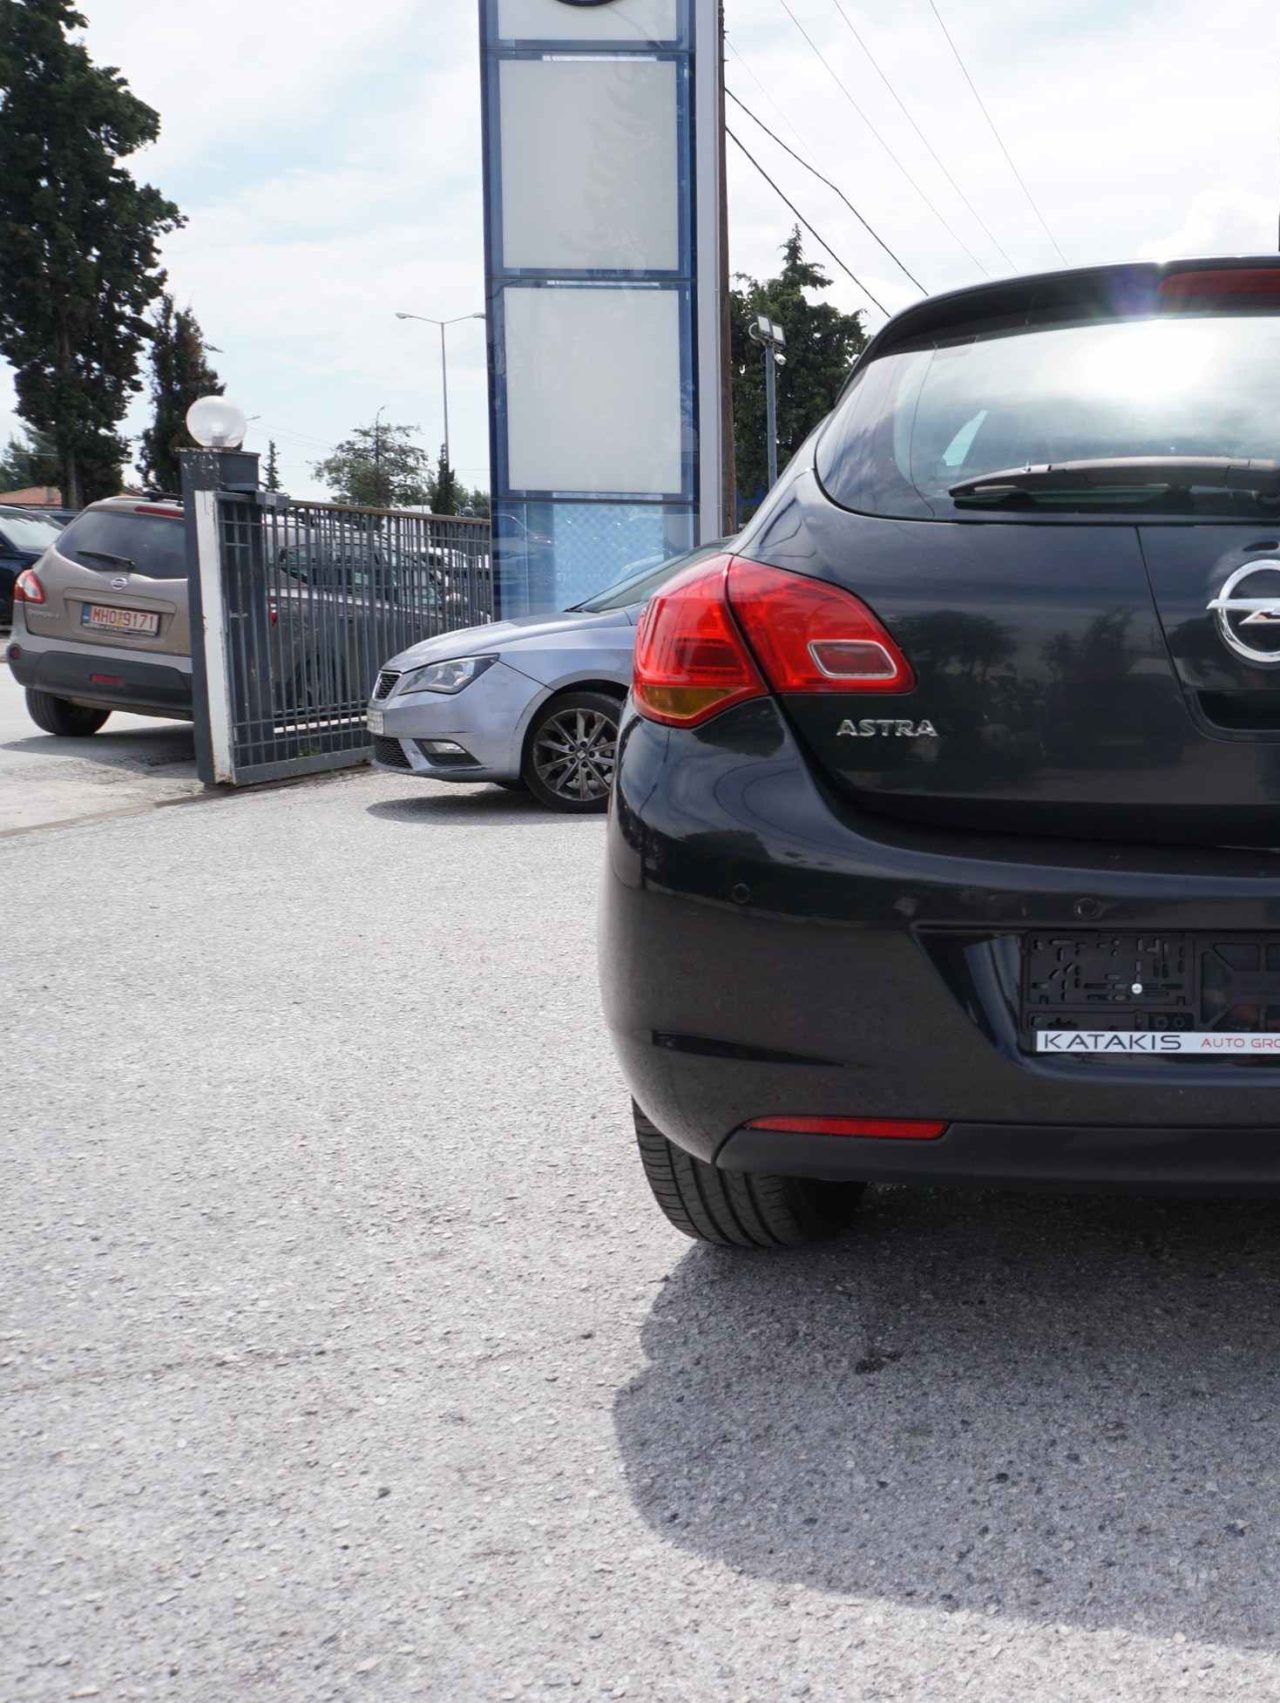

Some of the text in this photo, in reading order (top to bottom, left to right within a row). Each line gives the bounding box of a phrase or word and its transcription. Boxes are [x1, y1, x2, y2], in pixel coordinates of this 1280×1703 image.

[836, 719, 938, 737] ASTRA
[1043, 1033, 1182, 1051] KATAKIS
[1200, 1037, 1245, 1048] AUTO
